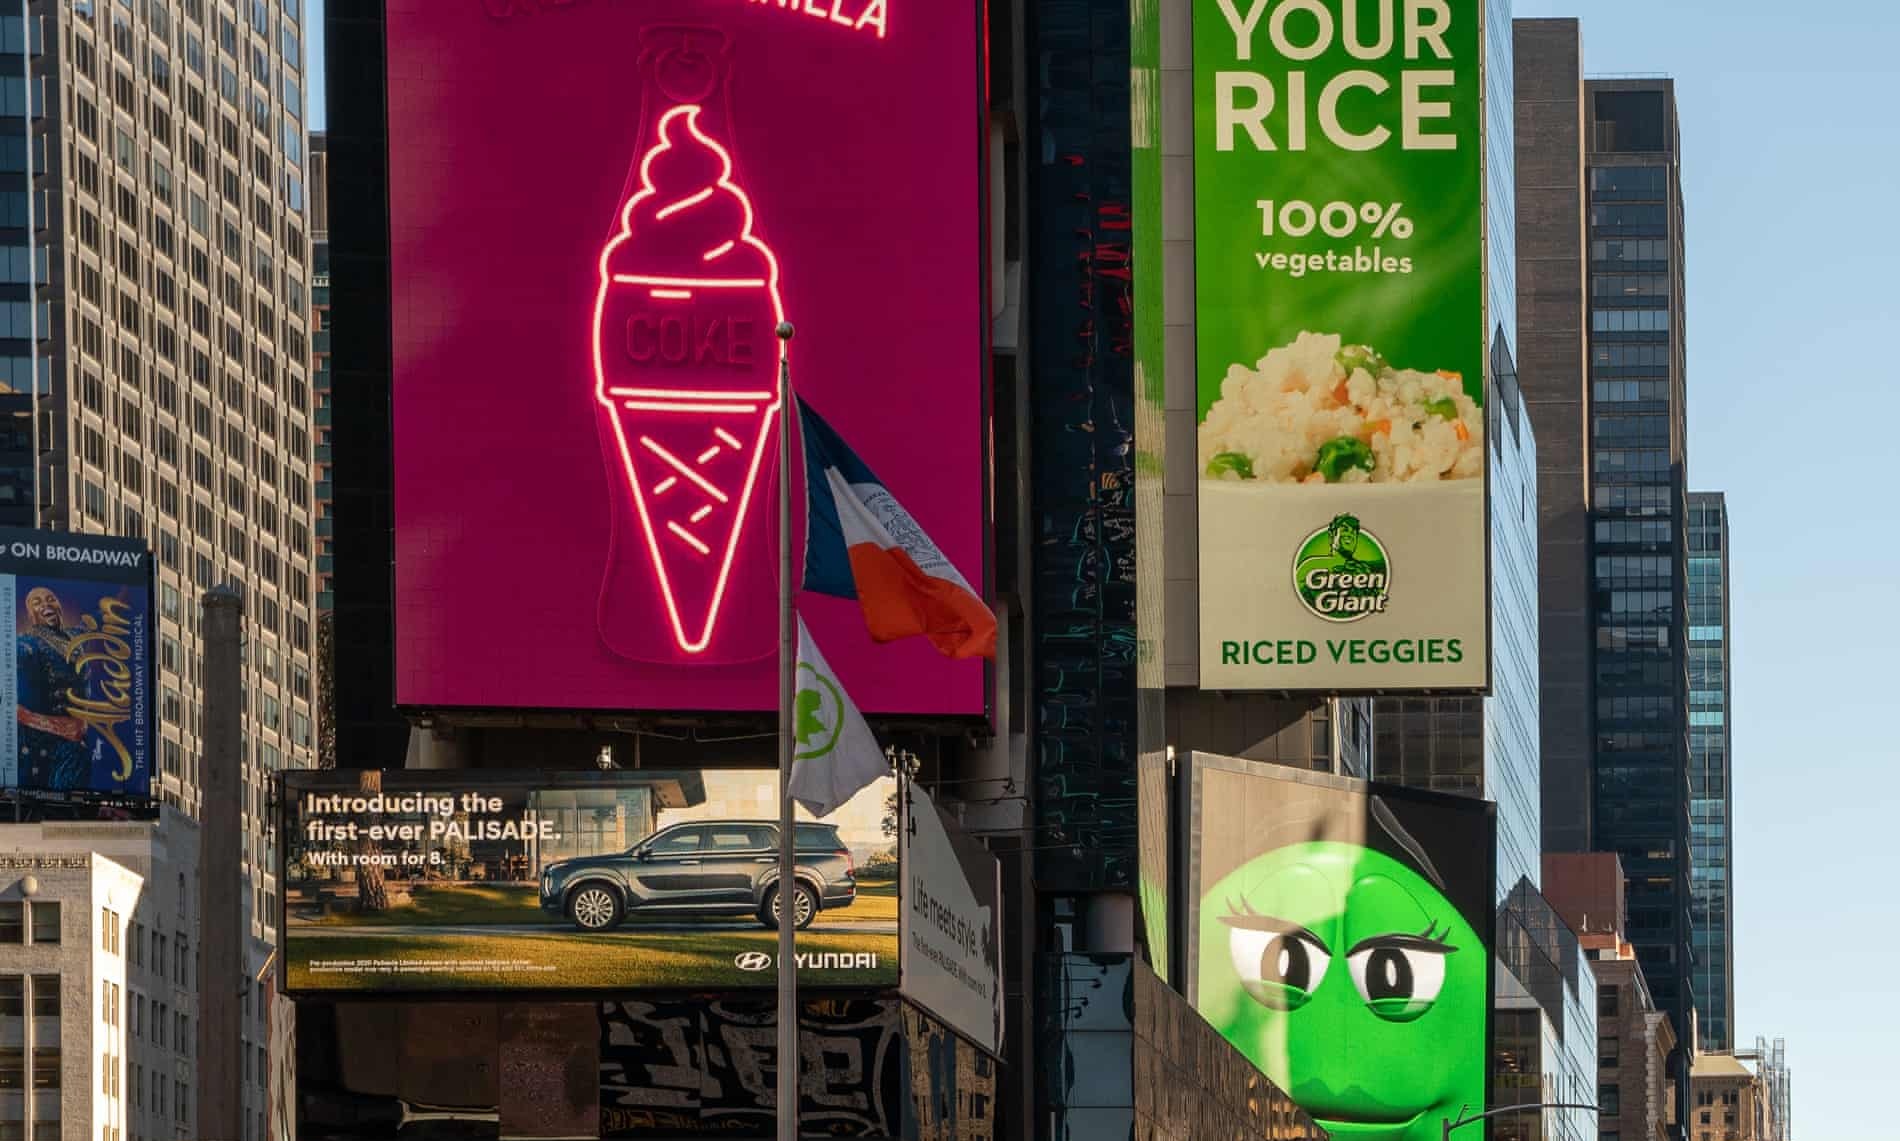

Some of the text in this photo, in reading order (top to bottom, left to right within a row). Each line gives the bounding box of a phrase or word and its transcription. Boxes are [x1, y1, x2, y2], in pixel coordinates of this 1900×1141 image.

[1216, 0, 1454, 61] YOUR
[1215, 70, 1458, 152] RICE
[1256, 199, 1414, 240] 100%
[1255, 247, 1413, 279] vegetables
[626, 312, 754, 368] COKE
[10, 541, 141, 568] ON BROADWAY
[1304, 568, 1385, 592] Green
[1315, 590, 1390, 614] Giant
[1221, 638, 1463, 666] RICED VEGGIES
[66, 596, 133, 782] Aladdin
[134, 613, 144, 769] THE HIT BROADWAY MUSICAL
[307, 791, 503, 816] Introducing the
[306, 819, 562, 841] first-ever PALISADE.
[307, 851, 446, 865] With room for 8.
[912, 874, 978, 958] Life meets style.
[776, 952, 877, 969] YUNDAI
